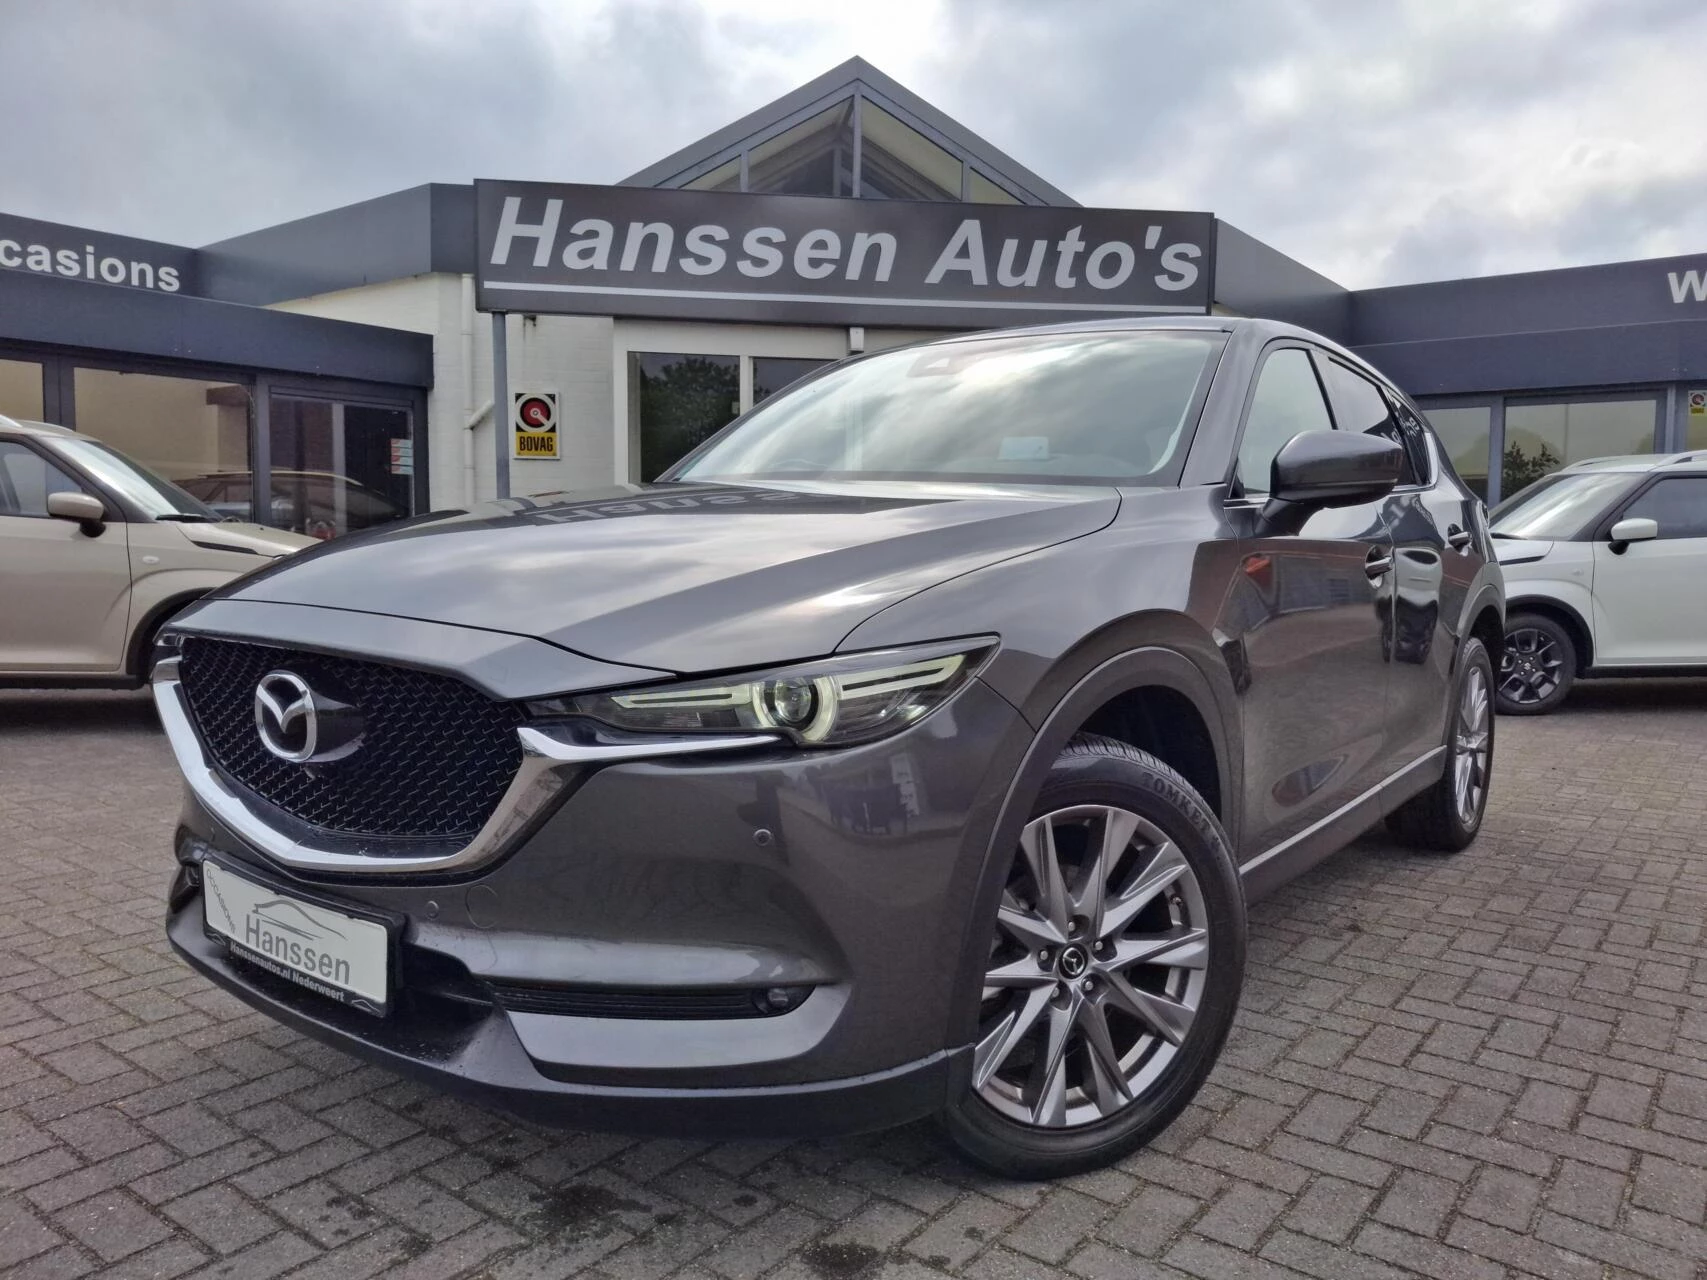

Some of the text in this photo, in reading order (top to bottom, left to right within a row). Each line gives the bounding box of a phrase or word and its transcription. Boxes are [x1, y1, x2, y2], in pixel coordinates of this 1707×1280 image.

[0, 239, 180, 292] casions
[490, 196, 1203, 292] Hanssen Auto's
[519, 436, 554, 452] BOVAG
[230, 940, 345, 1002] Hanssenautos.nl Nederweert
[246, 913, 350, 985] Hanssen
